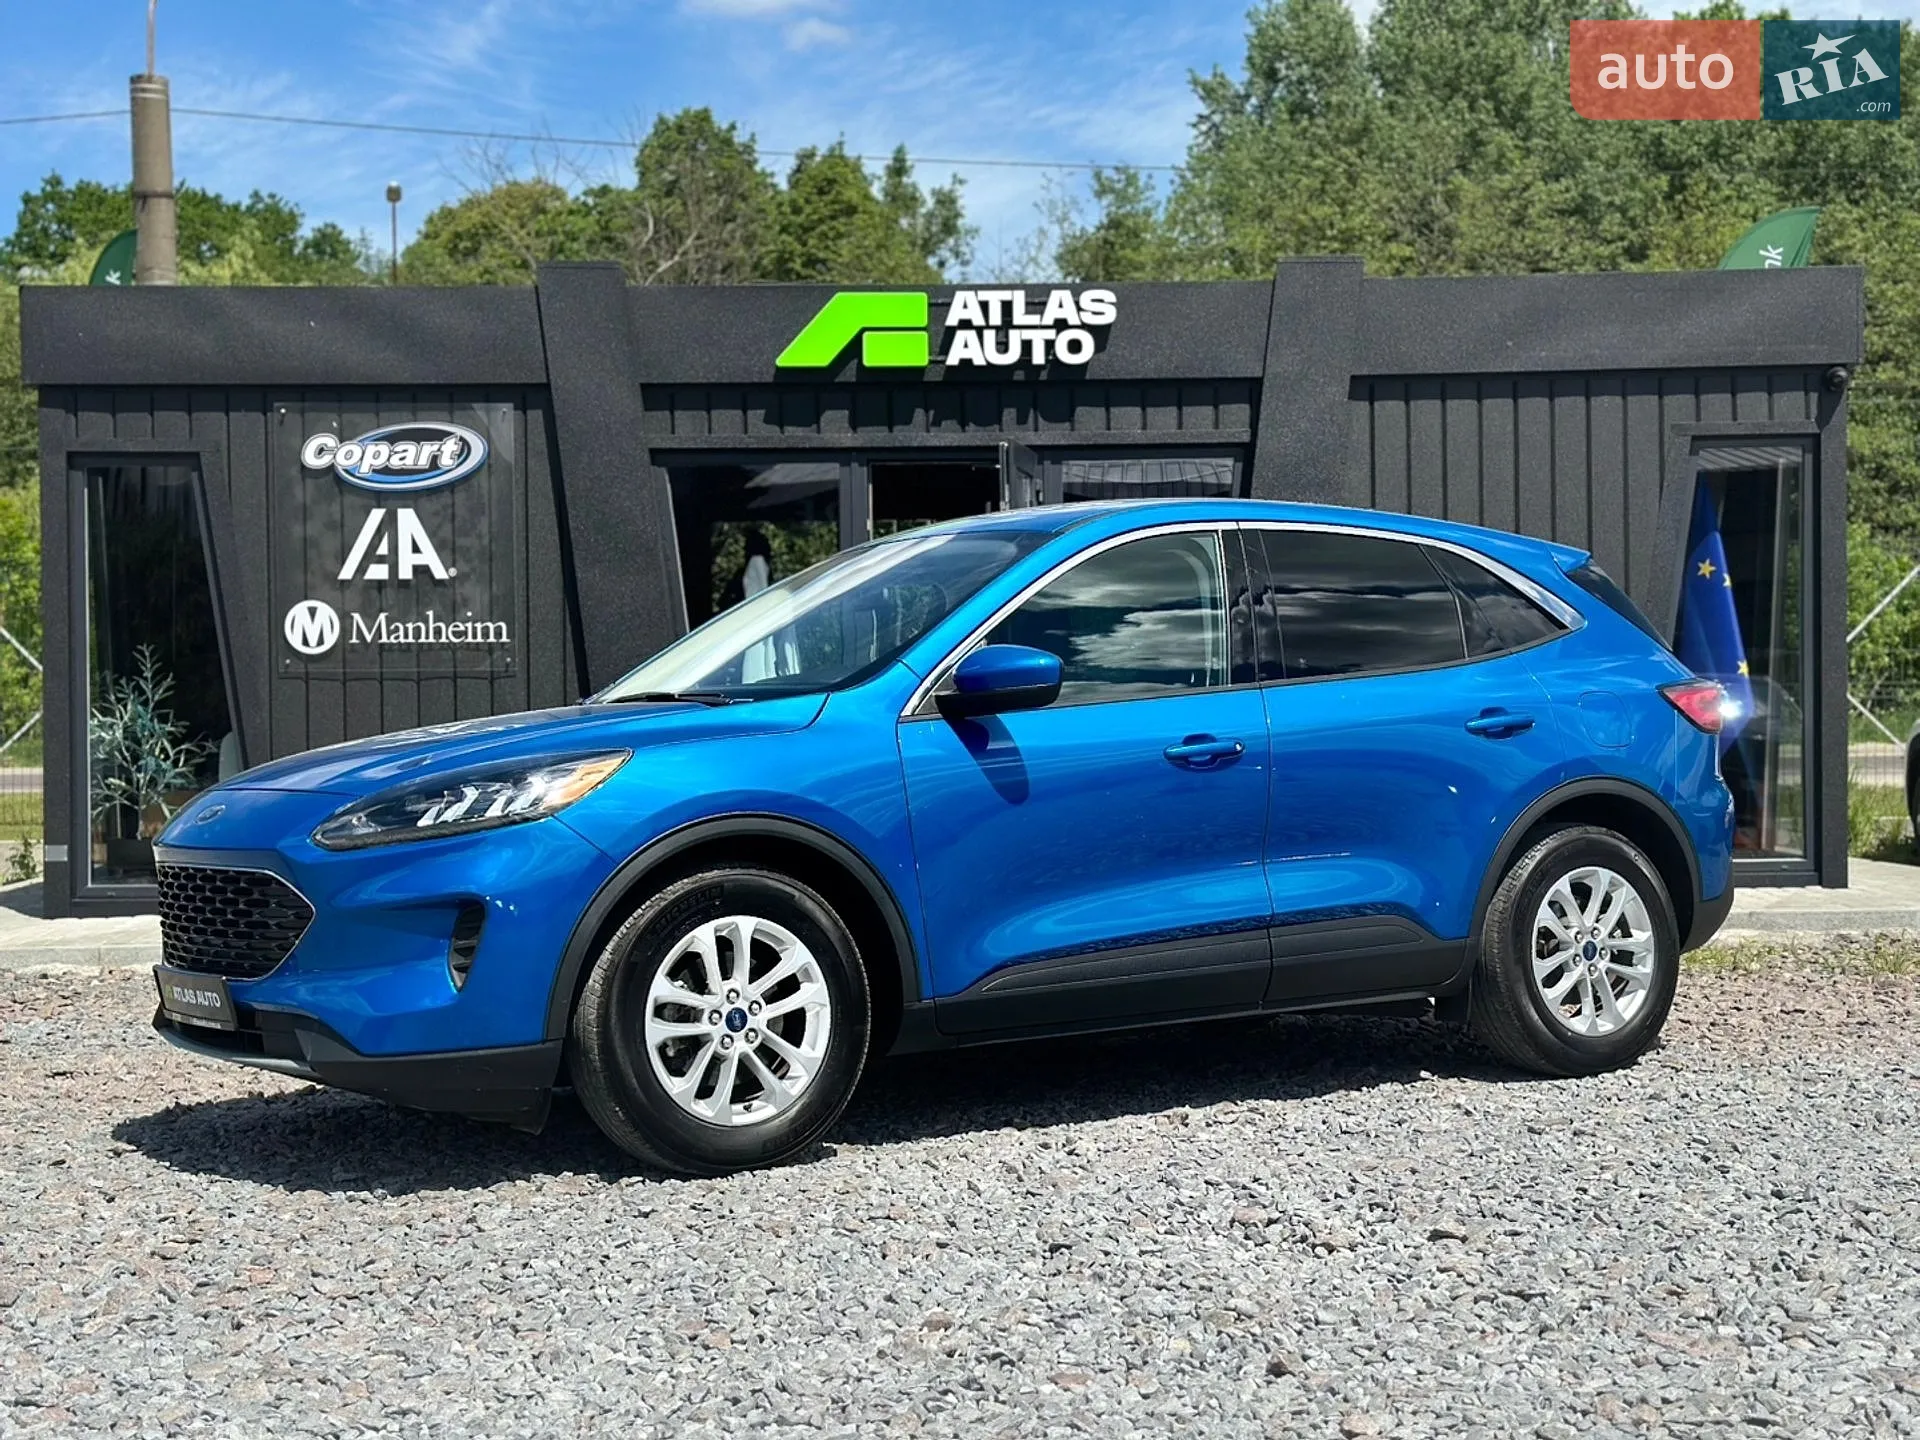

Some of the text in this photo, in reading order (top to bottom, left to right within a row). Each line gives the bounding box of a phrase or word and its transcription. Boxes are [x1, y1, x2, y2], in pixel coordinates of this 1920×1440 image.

[944, 289, 1118, 327] ATLAS
[945, 328, 1096, 365] AUTO
[301, 432, 463, 475] Copart
[348, 610, 511, 644] Manheim
[172, 985, 222, 1008] ATLAS AUTO
